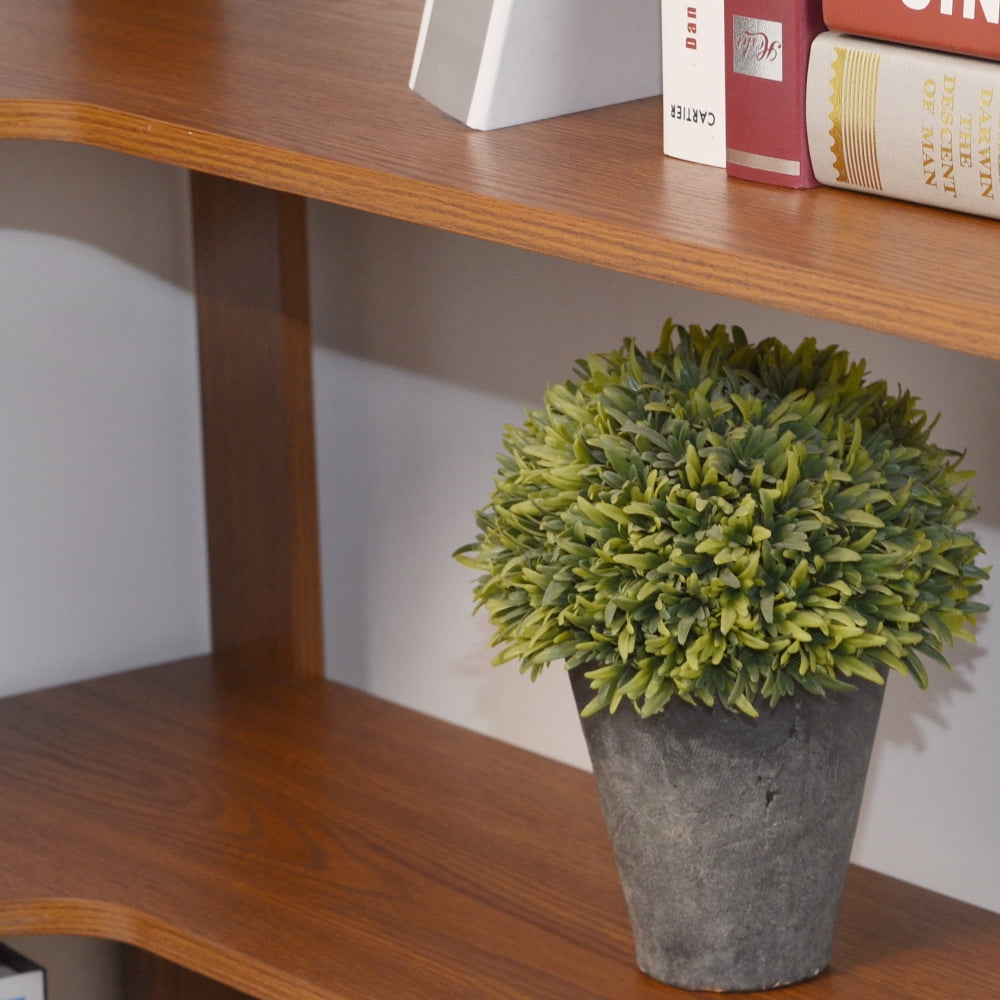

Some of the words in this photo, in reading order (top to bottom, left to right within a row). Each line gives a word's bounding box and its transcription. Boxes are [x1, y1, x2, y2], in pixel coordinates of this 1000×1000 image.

[671, 104, 716, 127] CARTIER
[922, 78, 937, 115] OF
[921, 127, 937, 189] MAN
[940, 74, 957, 198] DESCENT
[959, 113, 973, 168] THE
[978, 88, 995, 200] DARWIN
